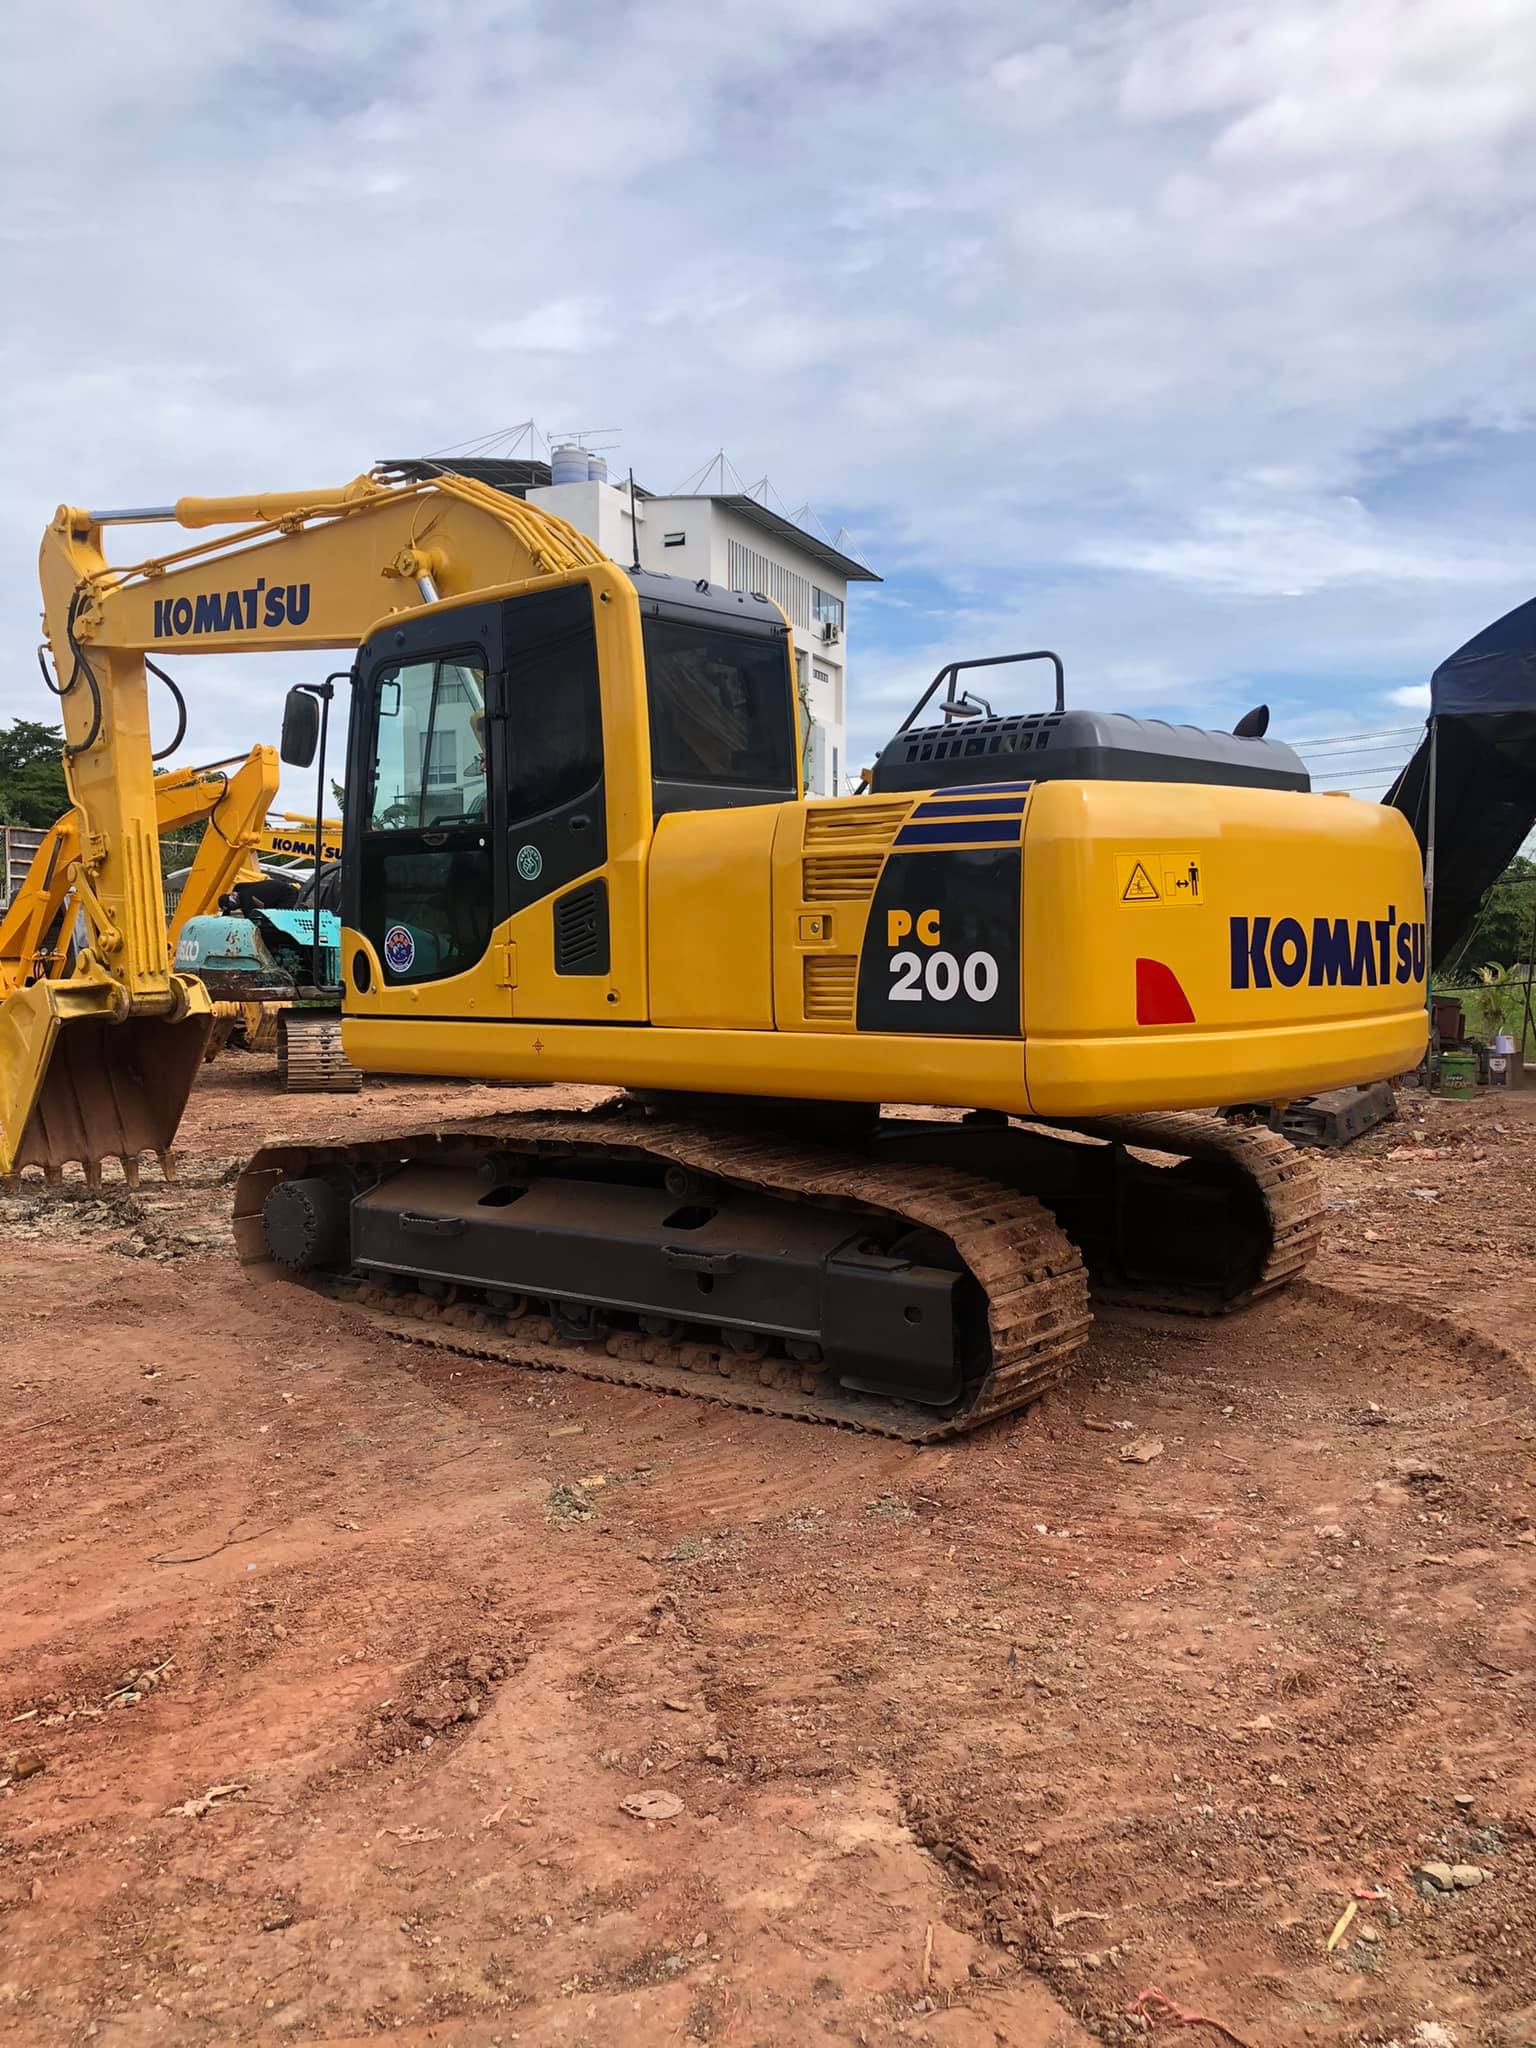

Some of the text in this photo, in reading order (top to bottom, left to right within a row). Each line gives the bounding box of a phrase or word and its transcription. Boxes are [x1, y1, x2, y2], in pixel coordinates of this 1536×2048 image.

[154, 578, 311, 638] KOMATSU
[272, 838, 342, 859] KOMASU
[888, 909, 941, 947] PC
[1230, 905, 1425, 989] KOMATSU
[888, 951, 999, 1002] 200
